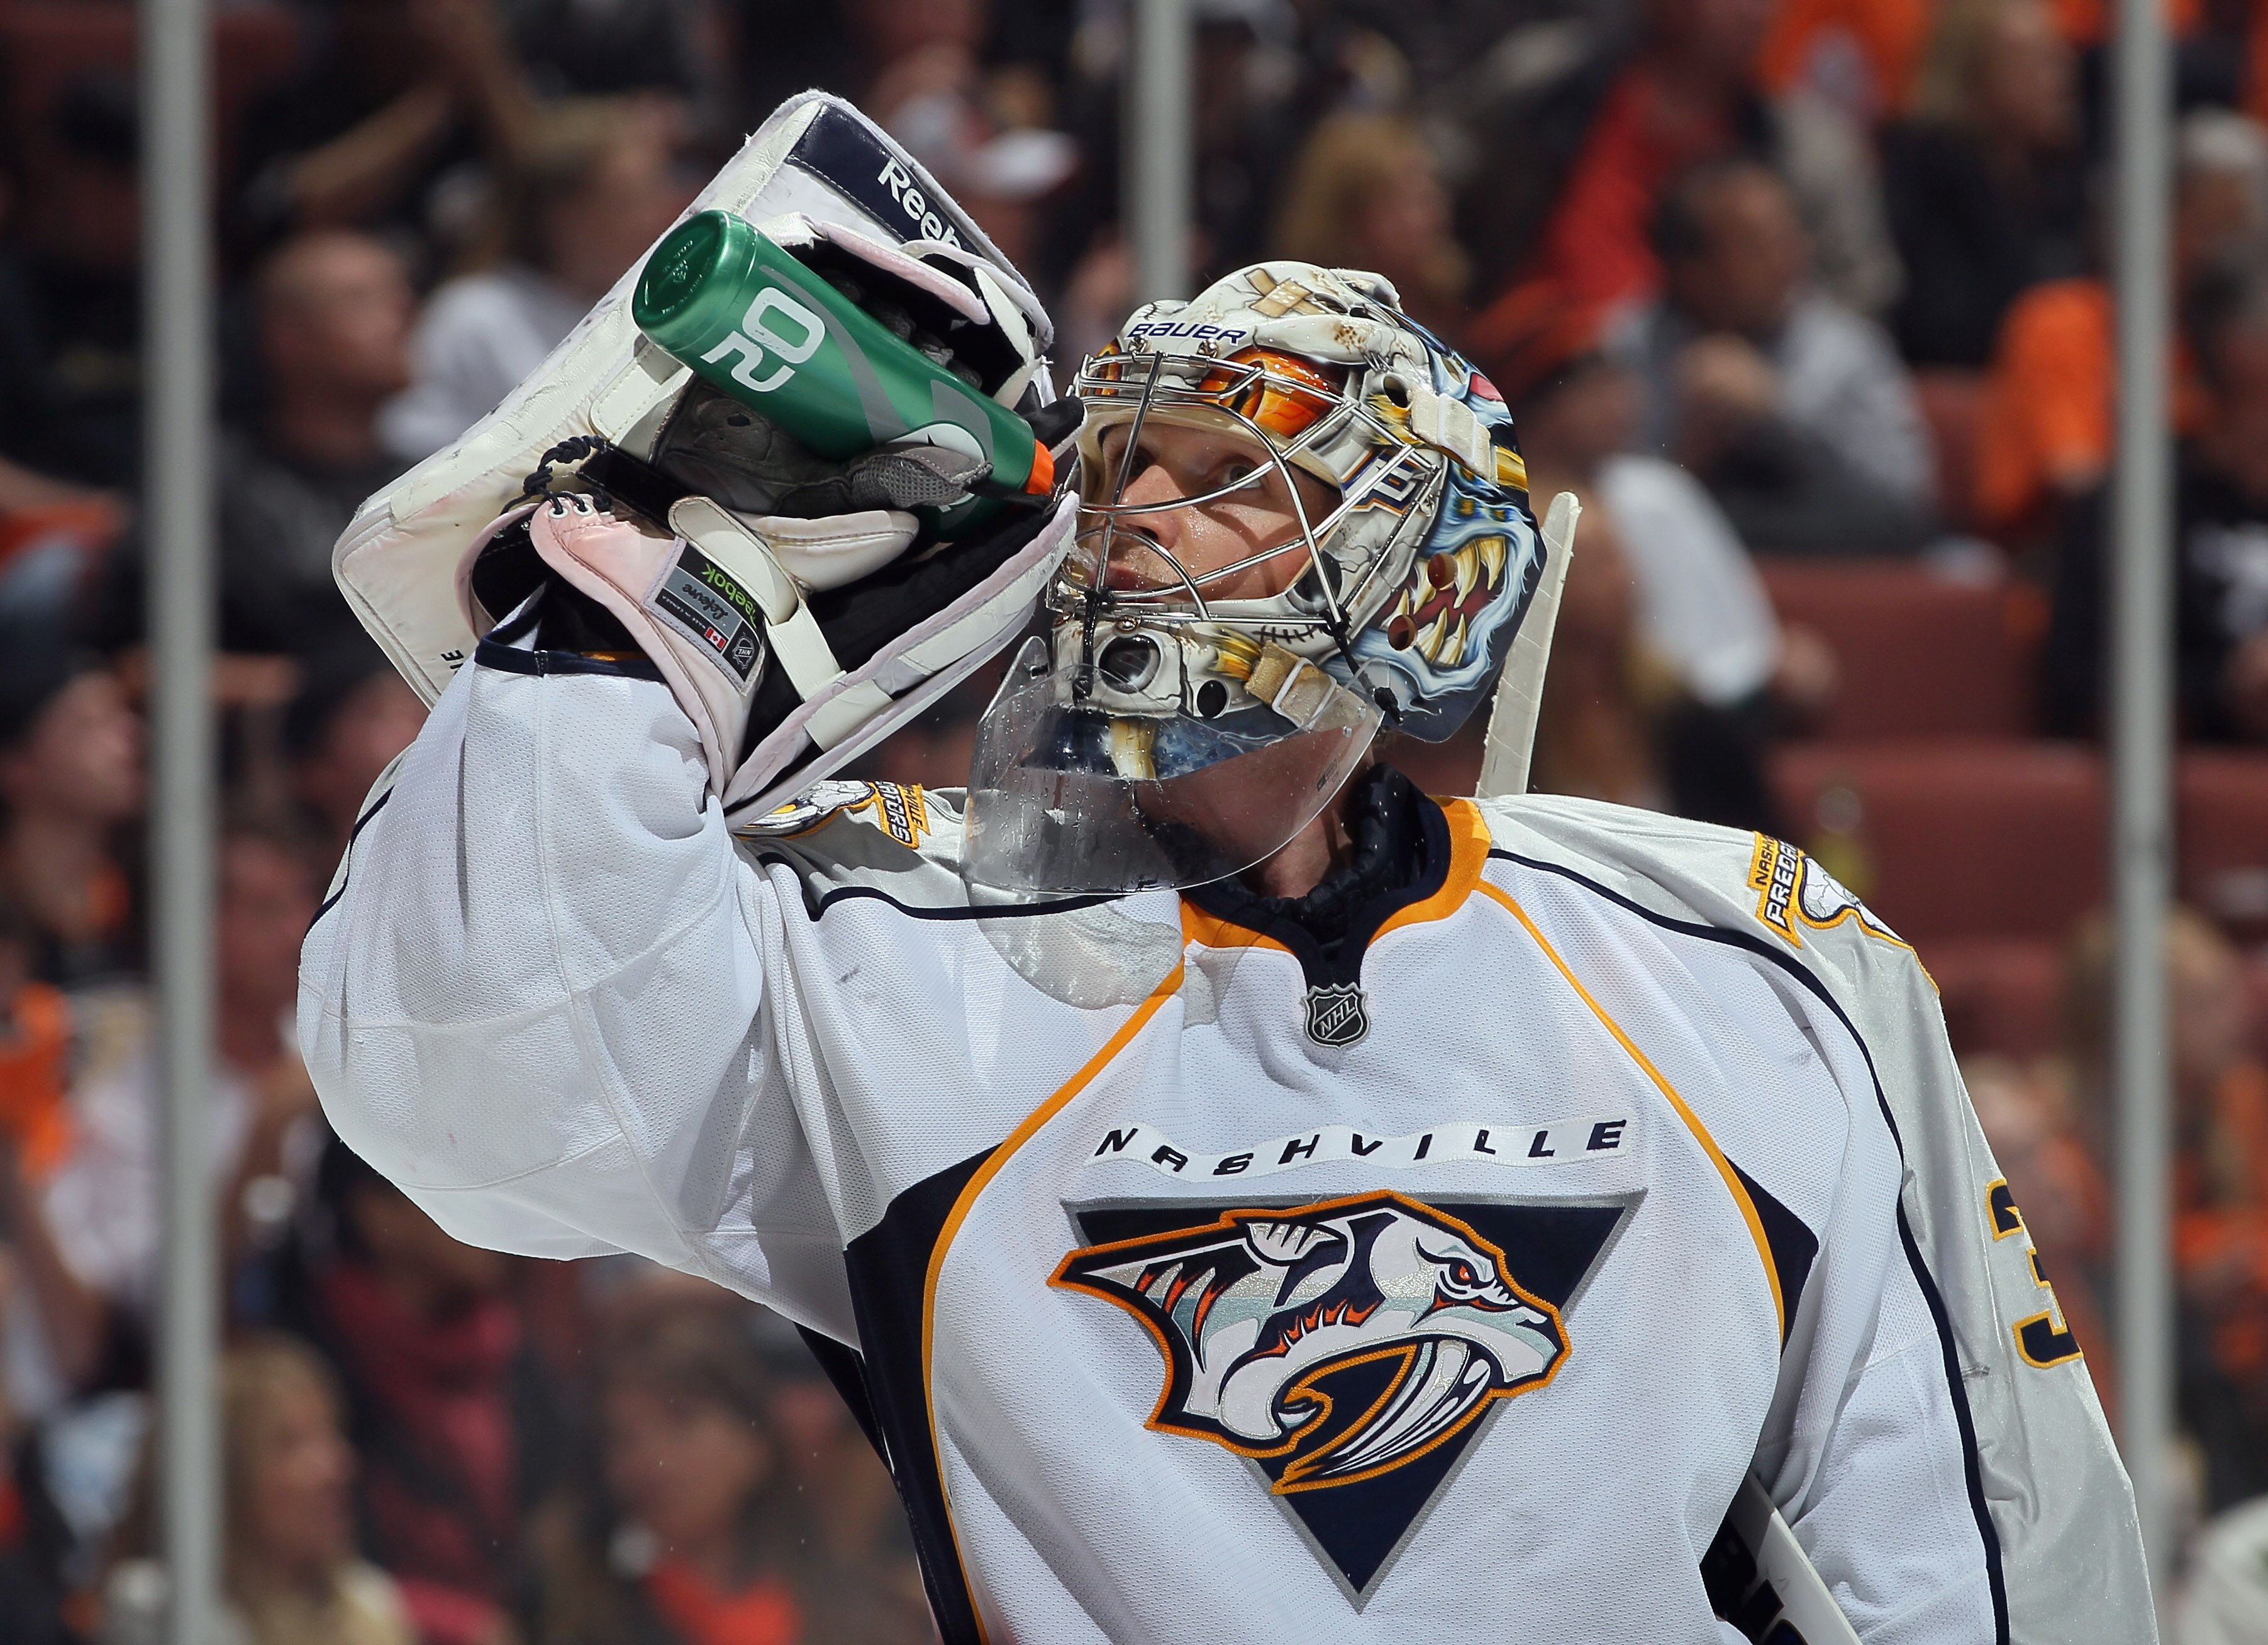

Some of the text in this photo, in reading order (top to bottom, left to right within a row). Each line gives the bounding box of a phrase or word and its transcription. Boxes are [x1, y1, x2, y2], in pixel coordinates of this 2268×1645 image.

[877, 157, 962, 250] Reeb
[875, 780, 913, 844] ATORS
[1320, 1000, 1355, 1036] NHL
[1094, 1119, 1627, 1176] NASHVILLE
